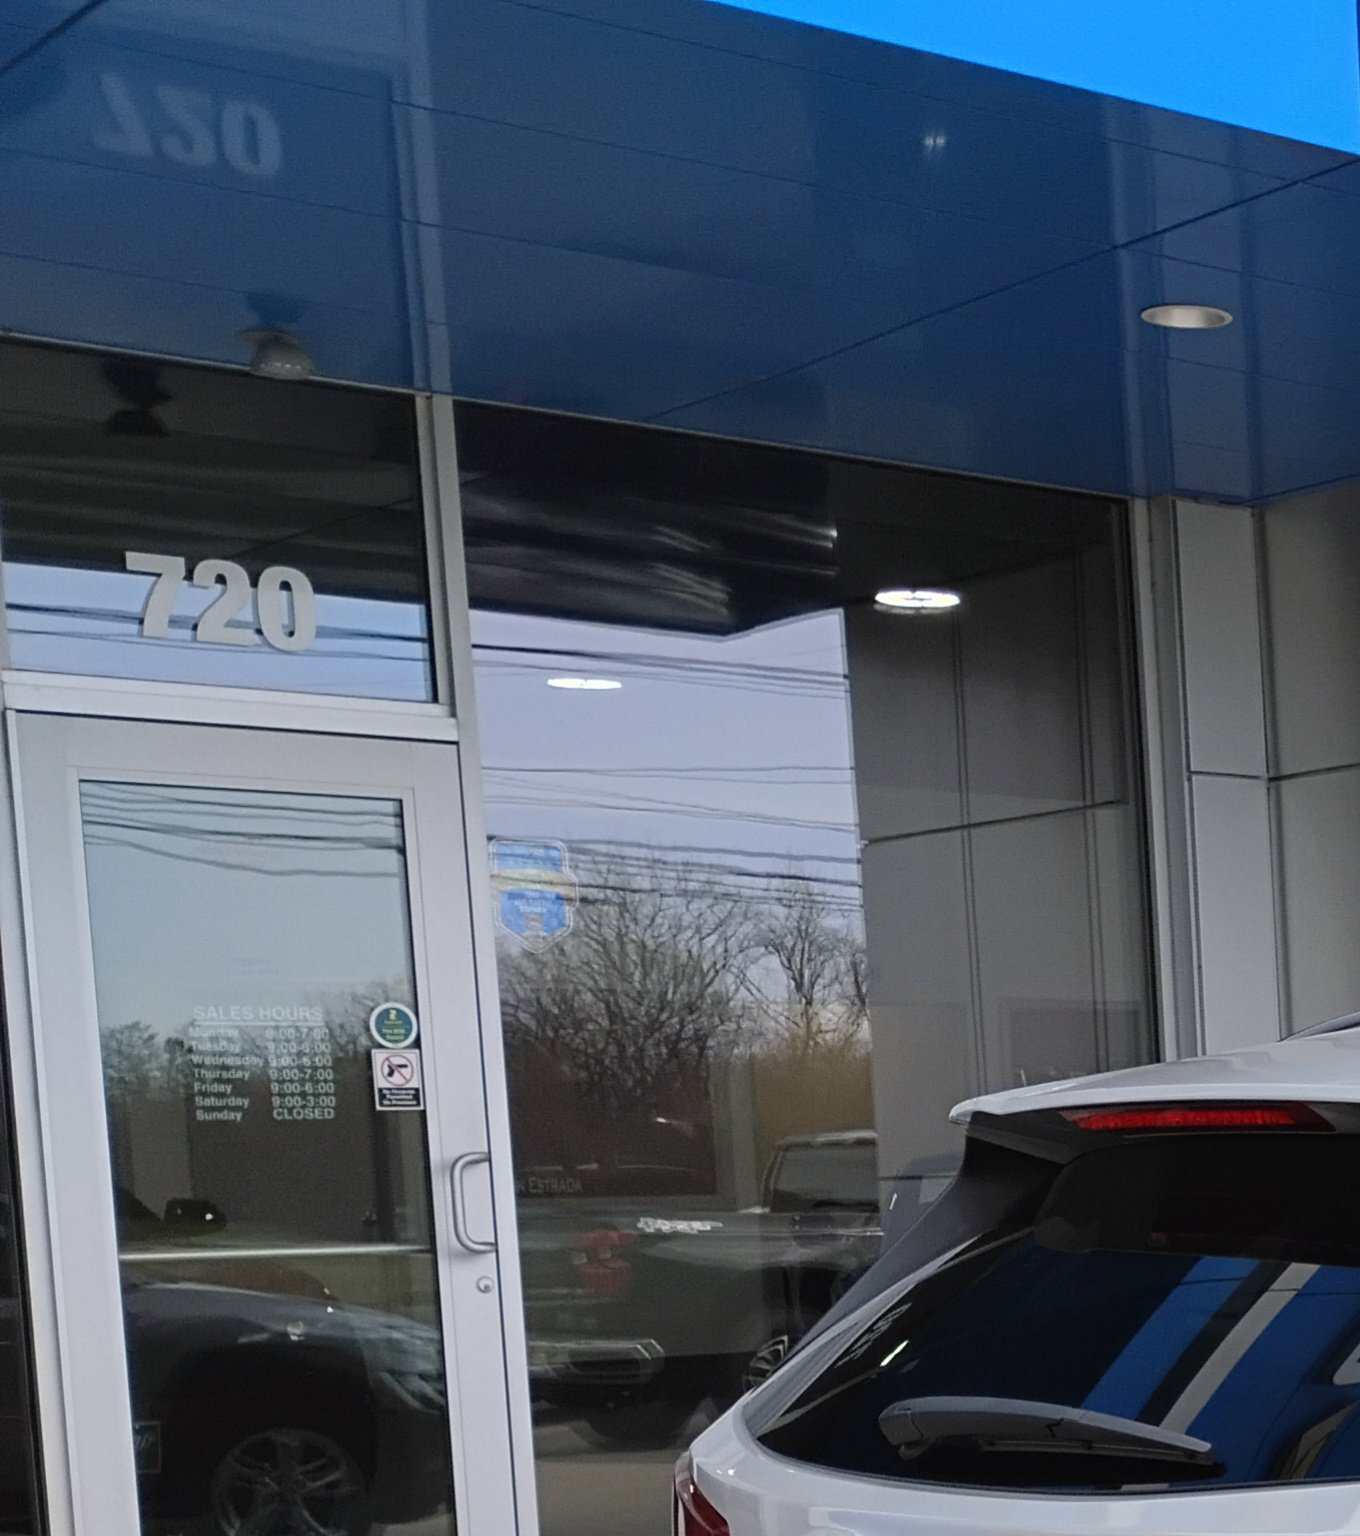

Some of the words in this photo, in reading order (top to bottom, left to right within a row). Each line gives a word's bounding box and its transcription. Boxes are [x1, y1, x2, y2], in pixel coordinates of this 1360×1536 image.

[125, 551, 317, 653] 720
[193, 1006, 254, 1021] SALES
[259, 1006, 324, 1021] HOURS
[189, 1026, 239, 1038] Monday
[191, 1041, 240, 1053] Tuesday
[192, 1054, 264, 1066] Wednesday
[194, 1068, 250, 1081] Thursday
[269, 1069, 334, 1080] 9:00-7:00
[194, 1082, 232, 1094] Friday
[195, 1096, 250, 1108] Saturday
[272, 1096, 336, 1107] 9:00-3:00
[195, 1109, 243, 1122] Sunday
[273, 1108, 335, 1120] CLOSED
